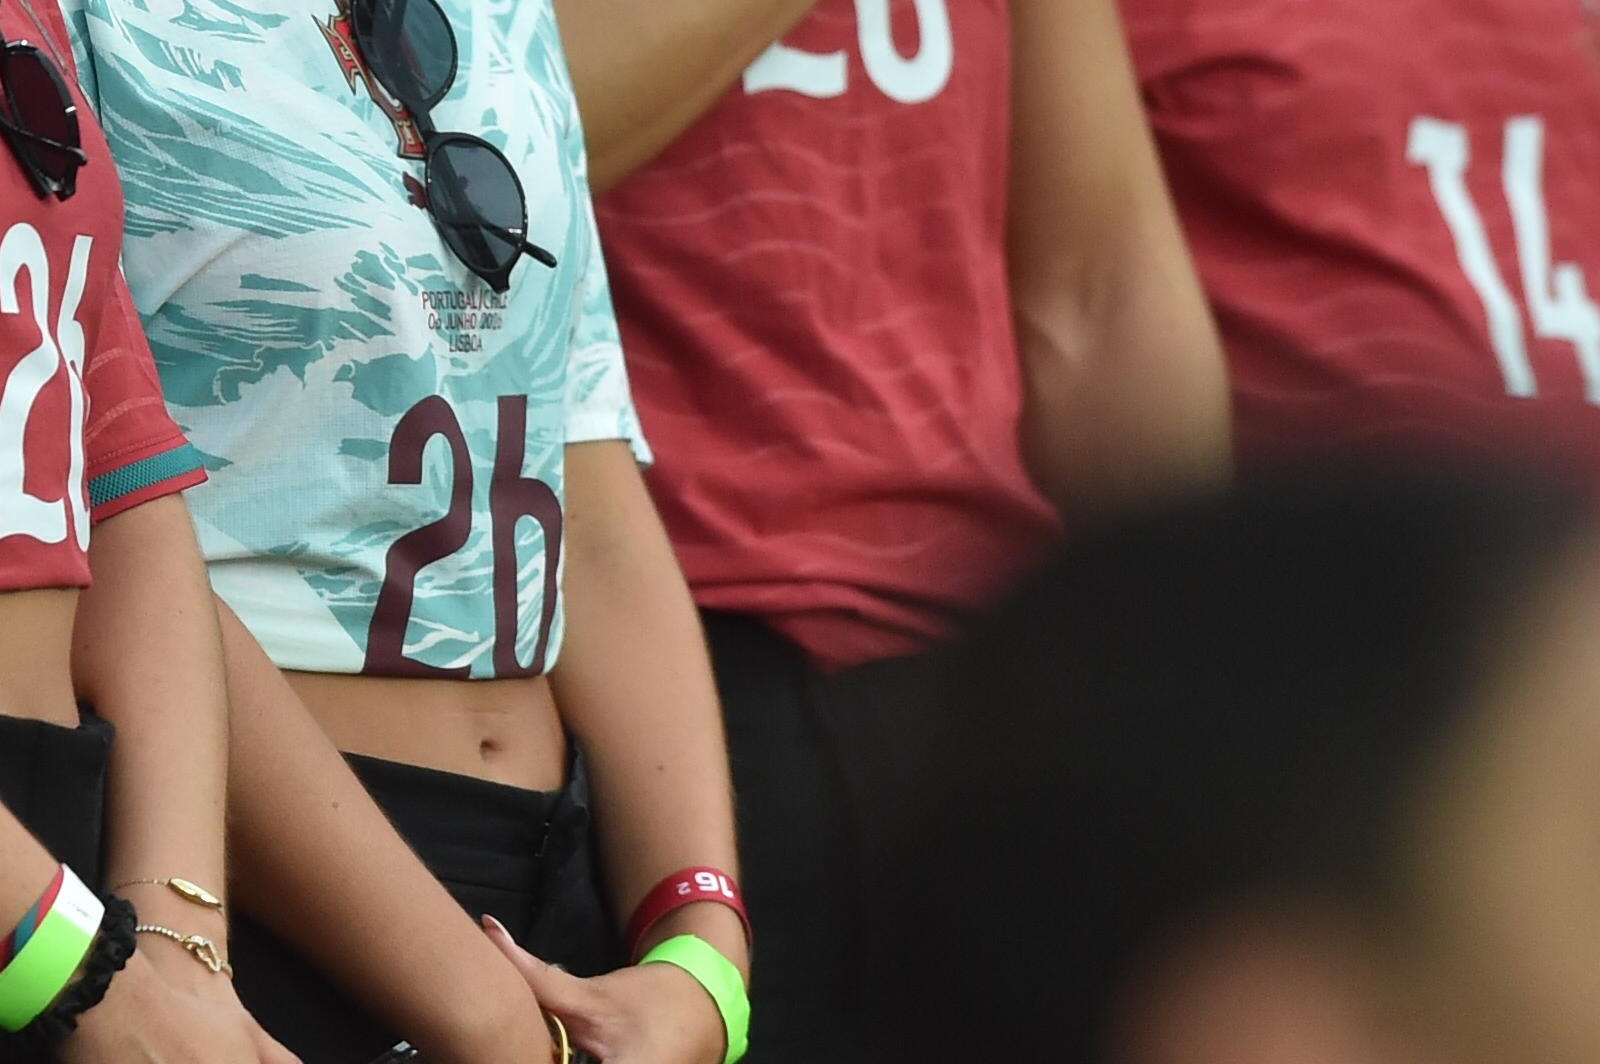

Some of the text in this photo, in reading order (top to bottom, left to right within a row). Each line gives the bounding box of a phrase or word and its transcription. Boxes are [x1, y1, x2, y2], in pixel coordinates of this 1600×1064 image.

[1406, 115, 1600, 406] 14
[446, 312, 477, 330] JUNHO
[449, 334, 483, 353] LISBOA
[361, 394, 564, 678] 26
[694, 872, 734, 898] 16
